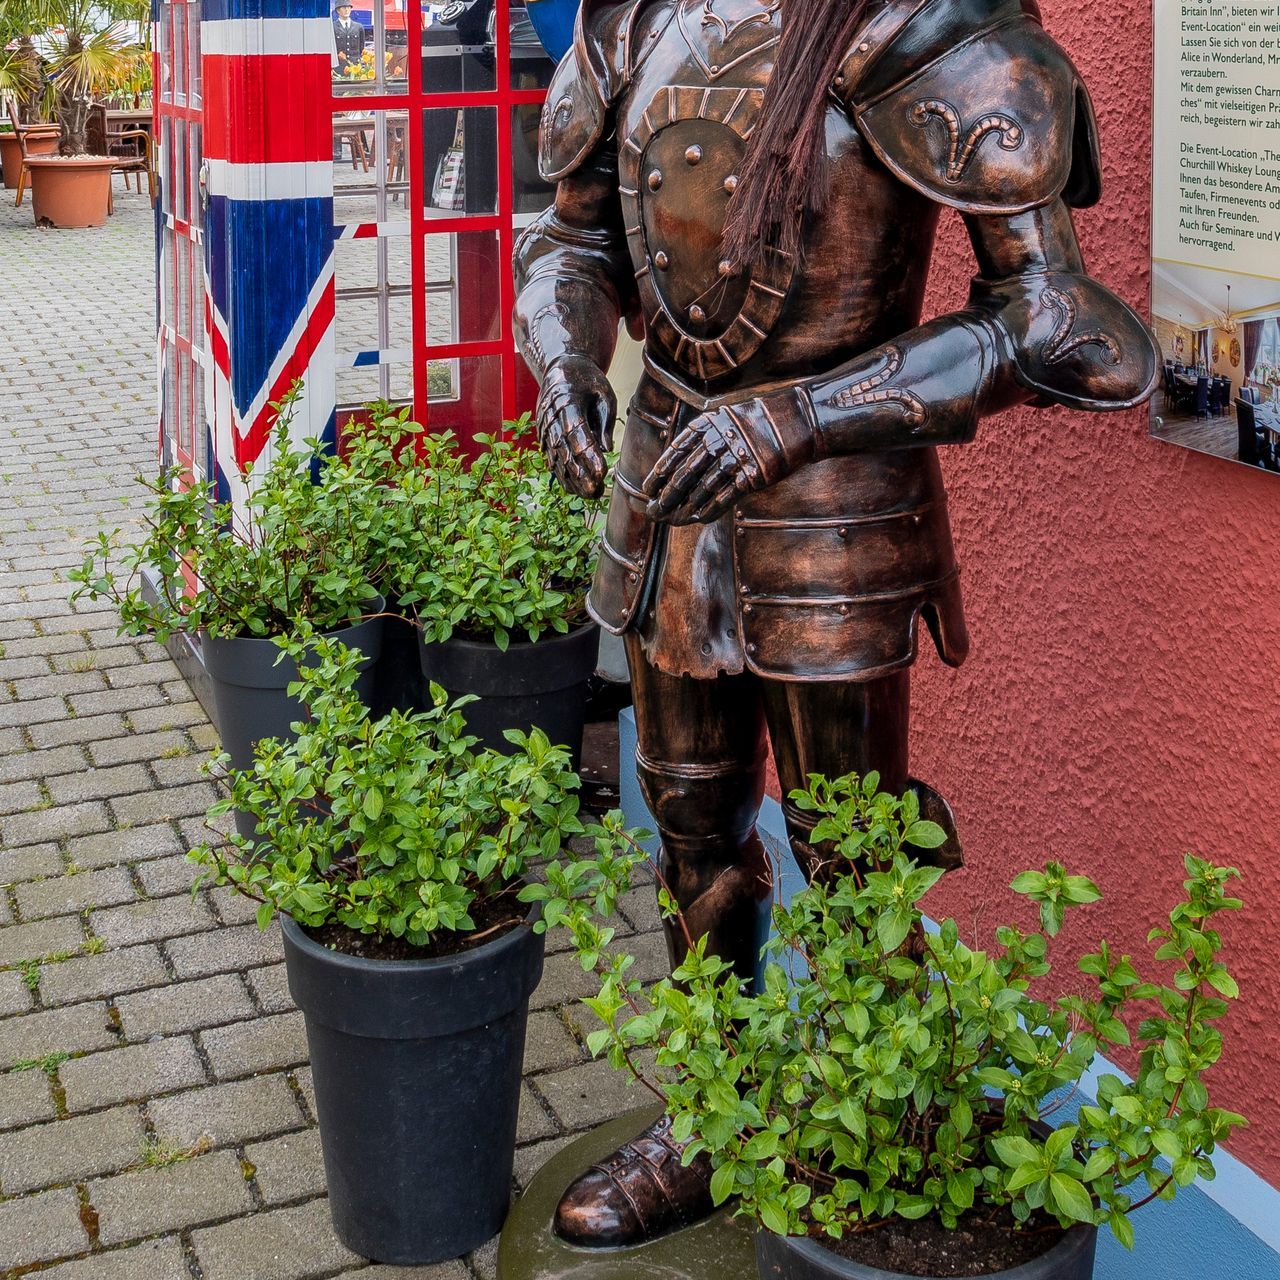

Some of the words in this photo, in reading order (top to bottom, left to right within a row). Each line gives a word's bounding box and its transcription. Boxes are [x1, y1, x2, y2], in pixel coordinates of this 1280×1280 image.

[1248, 21, 1261, 32] ein
[1180, 112, 1201, 125] reich,
[1203, 113, 1246, 127] begeistern
[1248, 117, 1263, 127] wir
[1179, 203, 1192, 214] mit
[1194, 204, 1215, 217] Ihren
[1217, 207, 1259, 223] Freunden.
